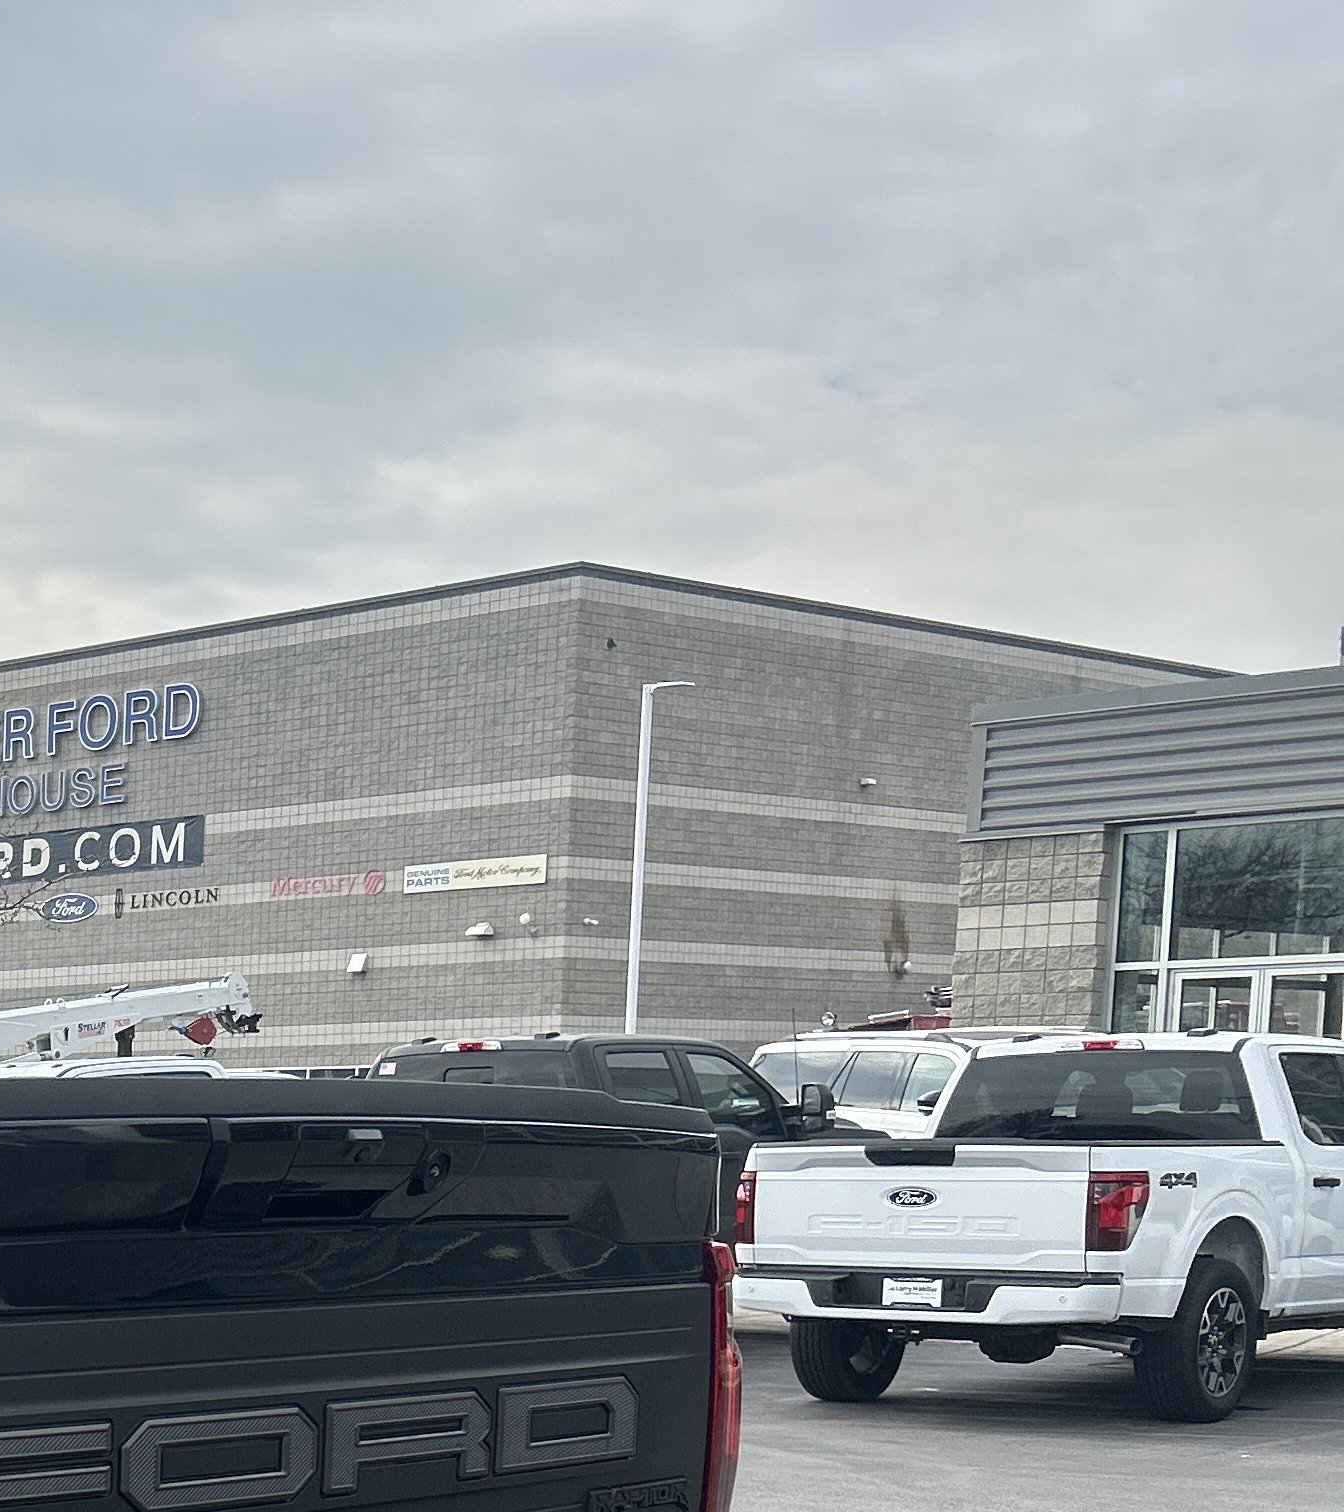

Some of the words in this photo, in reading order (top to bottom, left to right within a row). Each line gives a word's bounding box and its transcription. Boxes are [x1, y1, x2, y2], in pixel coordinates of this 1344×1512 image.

[47, 682, 200, 756] FORD
[406, 867, 450, 878] GENUINE
[406, 876, 450, 888] PARTS
[269, 874, 358, 898] Mercury
[52, 897, 86, 917] Ford
[130, 887, 220, 909] LINCOLN
[77, 1021, 106, 1033] STELLAR
[895, 1191, 927, 1205] Ford
[808, 1214, 1021, 1237] F-150
